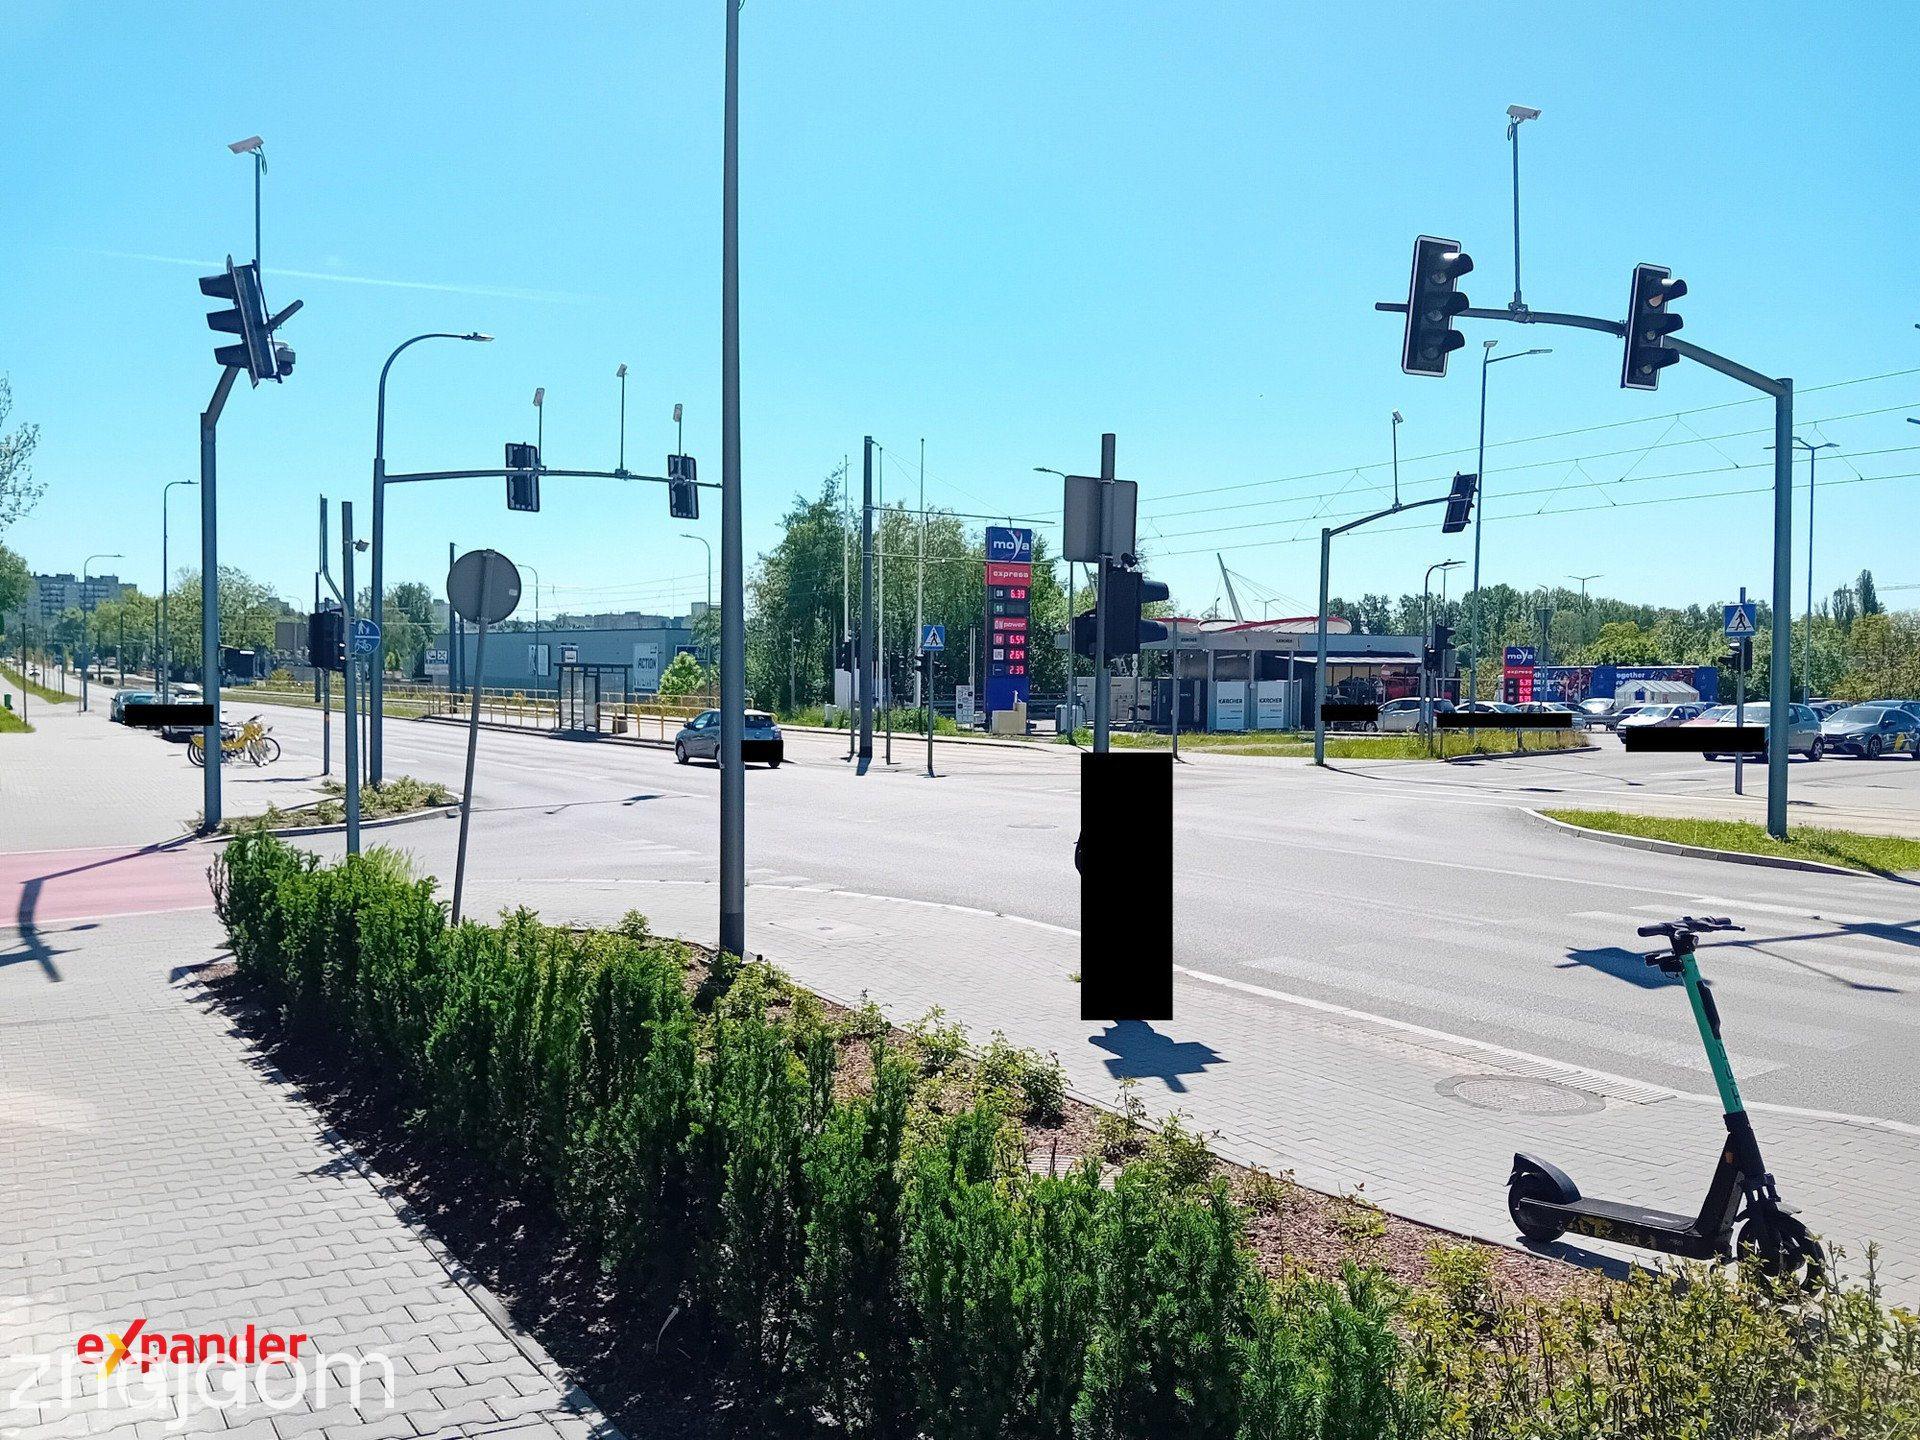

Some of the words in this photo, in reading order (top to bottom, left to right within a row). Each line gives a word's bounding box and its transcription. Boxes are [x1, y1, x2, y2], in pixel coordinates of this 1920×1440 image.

[993, 570, 1029, 578] express
[1010, 588, 1025, 599] 6.39
[1009, 650, 1025, 660] 2.64
[638, 657, 657, 669] ACTION
